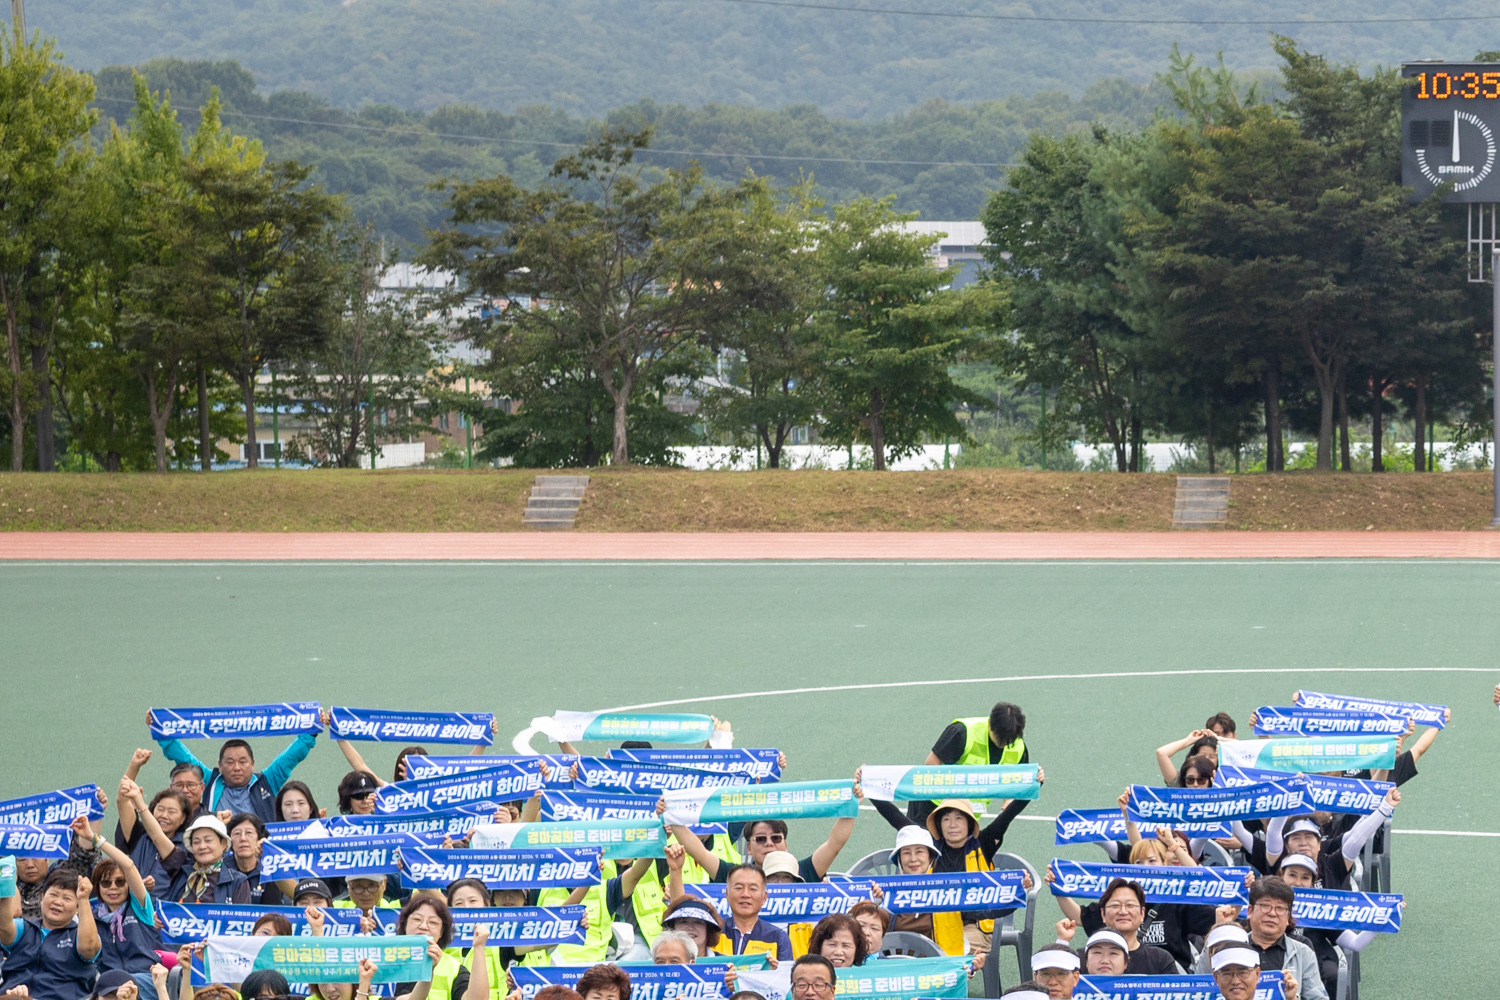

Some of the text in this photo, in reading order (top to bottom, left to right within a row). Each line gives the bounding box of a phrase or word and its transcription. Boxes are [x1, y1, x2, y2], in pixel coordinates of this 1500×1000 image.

[1438, 165, 1474, 174] SAMIK
[162, 714, 315, 734] 양주시 주민자치 화이팅
[338, 721, 485, 740] 양주시 주민자치 화이팅
[1262, 717, 1409, 733] 양주시 주민자치 화이팅
[1272, 743, 1388, 757] 경마공원은 준비된 양주로
[913, 772, 1032, 785] 경마공원은 준비된 양주로
[384, 774, 542, 812] 양주시 주민자치 화이팅
[721, 788, 851, 806] 경마공원은 준비된 양주로
[1139, 789, 1304, 819] 양주시 주민자치 화이팅
[528, 828, 659, 844] 경마공원은 준비된 양주로
[411, 860, 591, 882] 양주시 주민자치 화이팅
[272, 947, 425, 963] 경마공원은 준비된 양주로
